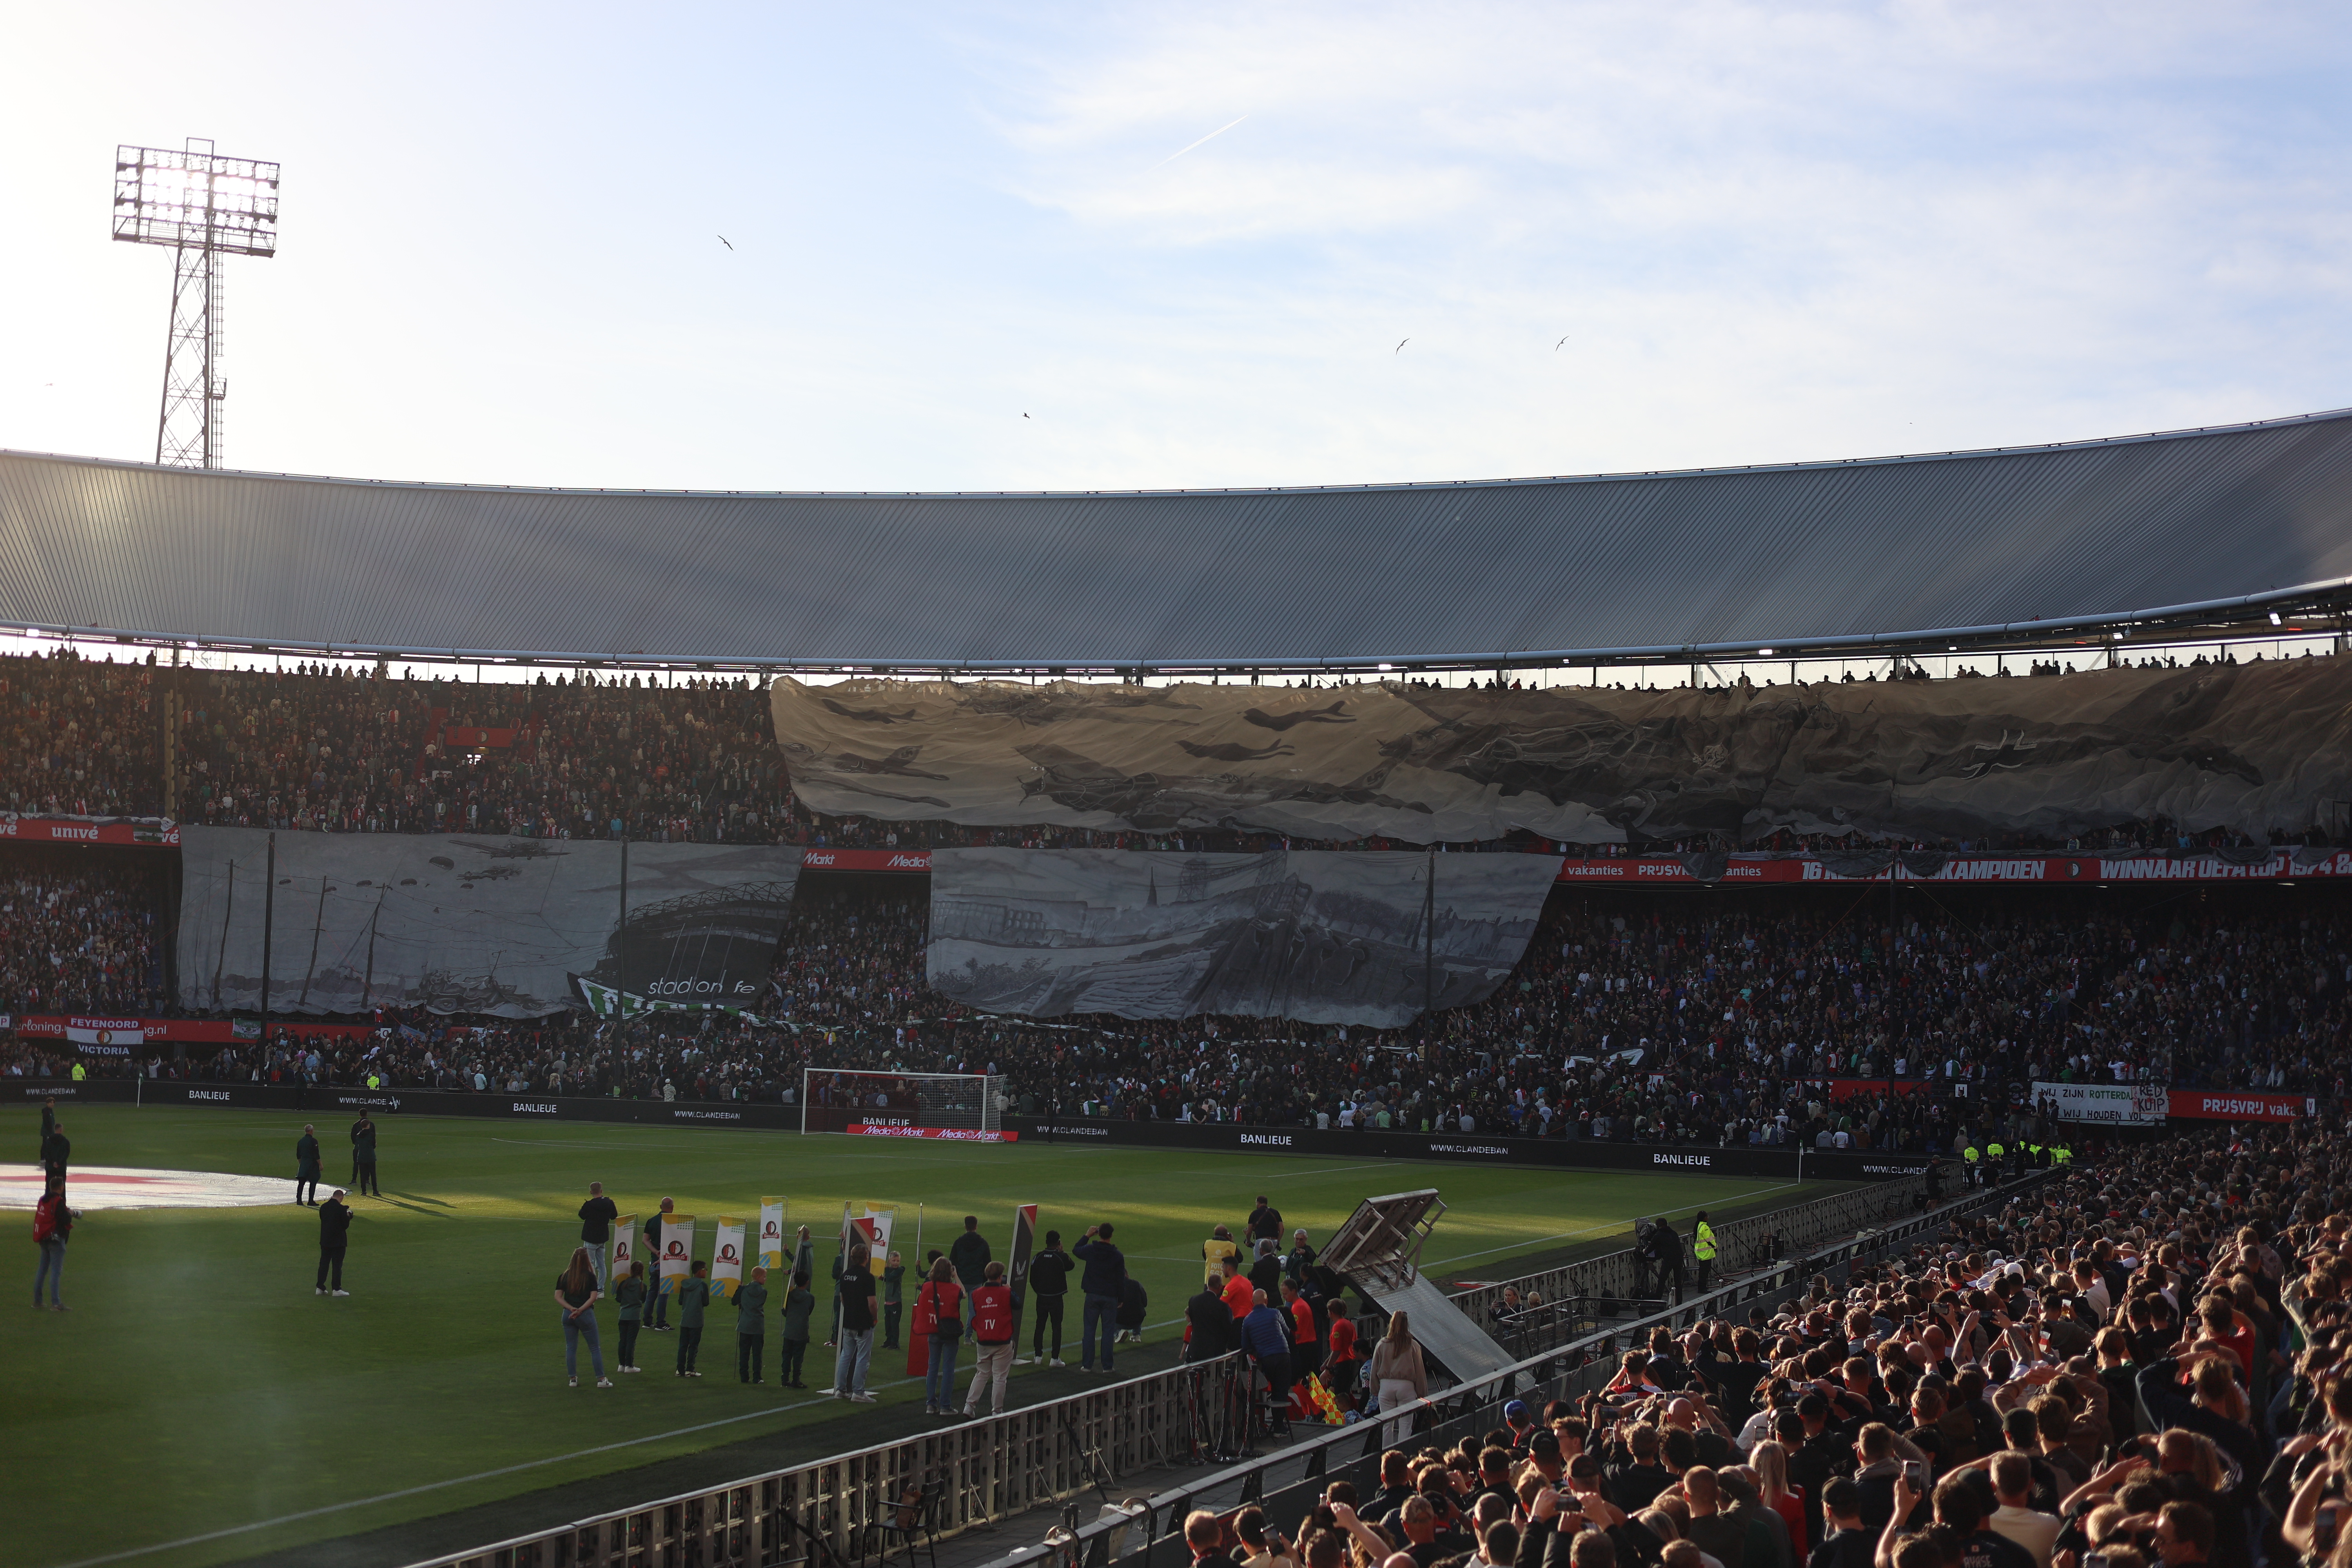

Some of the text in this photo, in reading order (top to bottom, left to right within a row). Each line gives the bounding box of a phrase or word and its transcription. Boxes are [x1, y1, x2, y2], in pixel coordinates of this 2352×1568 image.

[52, 826, 98, 839] univé
[804, 853, 835, 865] Markt
[887, 855, 925, 867] Media
[1568, 866, 1623, 875] vakanties
[1726, 866, 1762, 876] anties
[1802, 862, 1822, 880] 16
[2100, 859, 2196, 878] WINNAAR
[648, 976, 724, 995] stadion
[71, 1018, 139, 1029] FEYENOORD
[78, 1044, 130, 1055] VICTORIA
[189, 1091, 230, 1100] BANLIEUE
[2063, 1089, 2083, 1098] ZIJN
[2090, 1090, 2133, 1100] ROTTERDA
[2140, 1086, 2163, 1098] RED
[339, 1097, 400, 1105] WWW.CLANDEN
[2138, 1098, 2165, 1112] KUIP
[2203, 1099, 2264, 1114] PRIJSVRIJ
[514, 1103, 557, 1112] BANLIEUE
[675, 1111, 740, 1120] WWW.CLANDEBAN
[2064, 1109, 2144, 1121] WIJ HOUDEN VOL
[862, 1125, 924, 1137] Media Markt
[936, 1129, 1000, 1140] Media Markt
[1241, 1134, 1292, 1145] BANLIEUE
[1430, 1144, 1508, 1154] WWW.CLANDEBAN
[1654, 1154, 1711, 1166] BANLIEUE
[985, 1319, 996, 1330] TV
